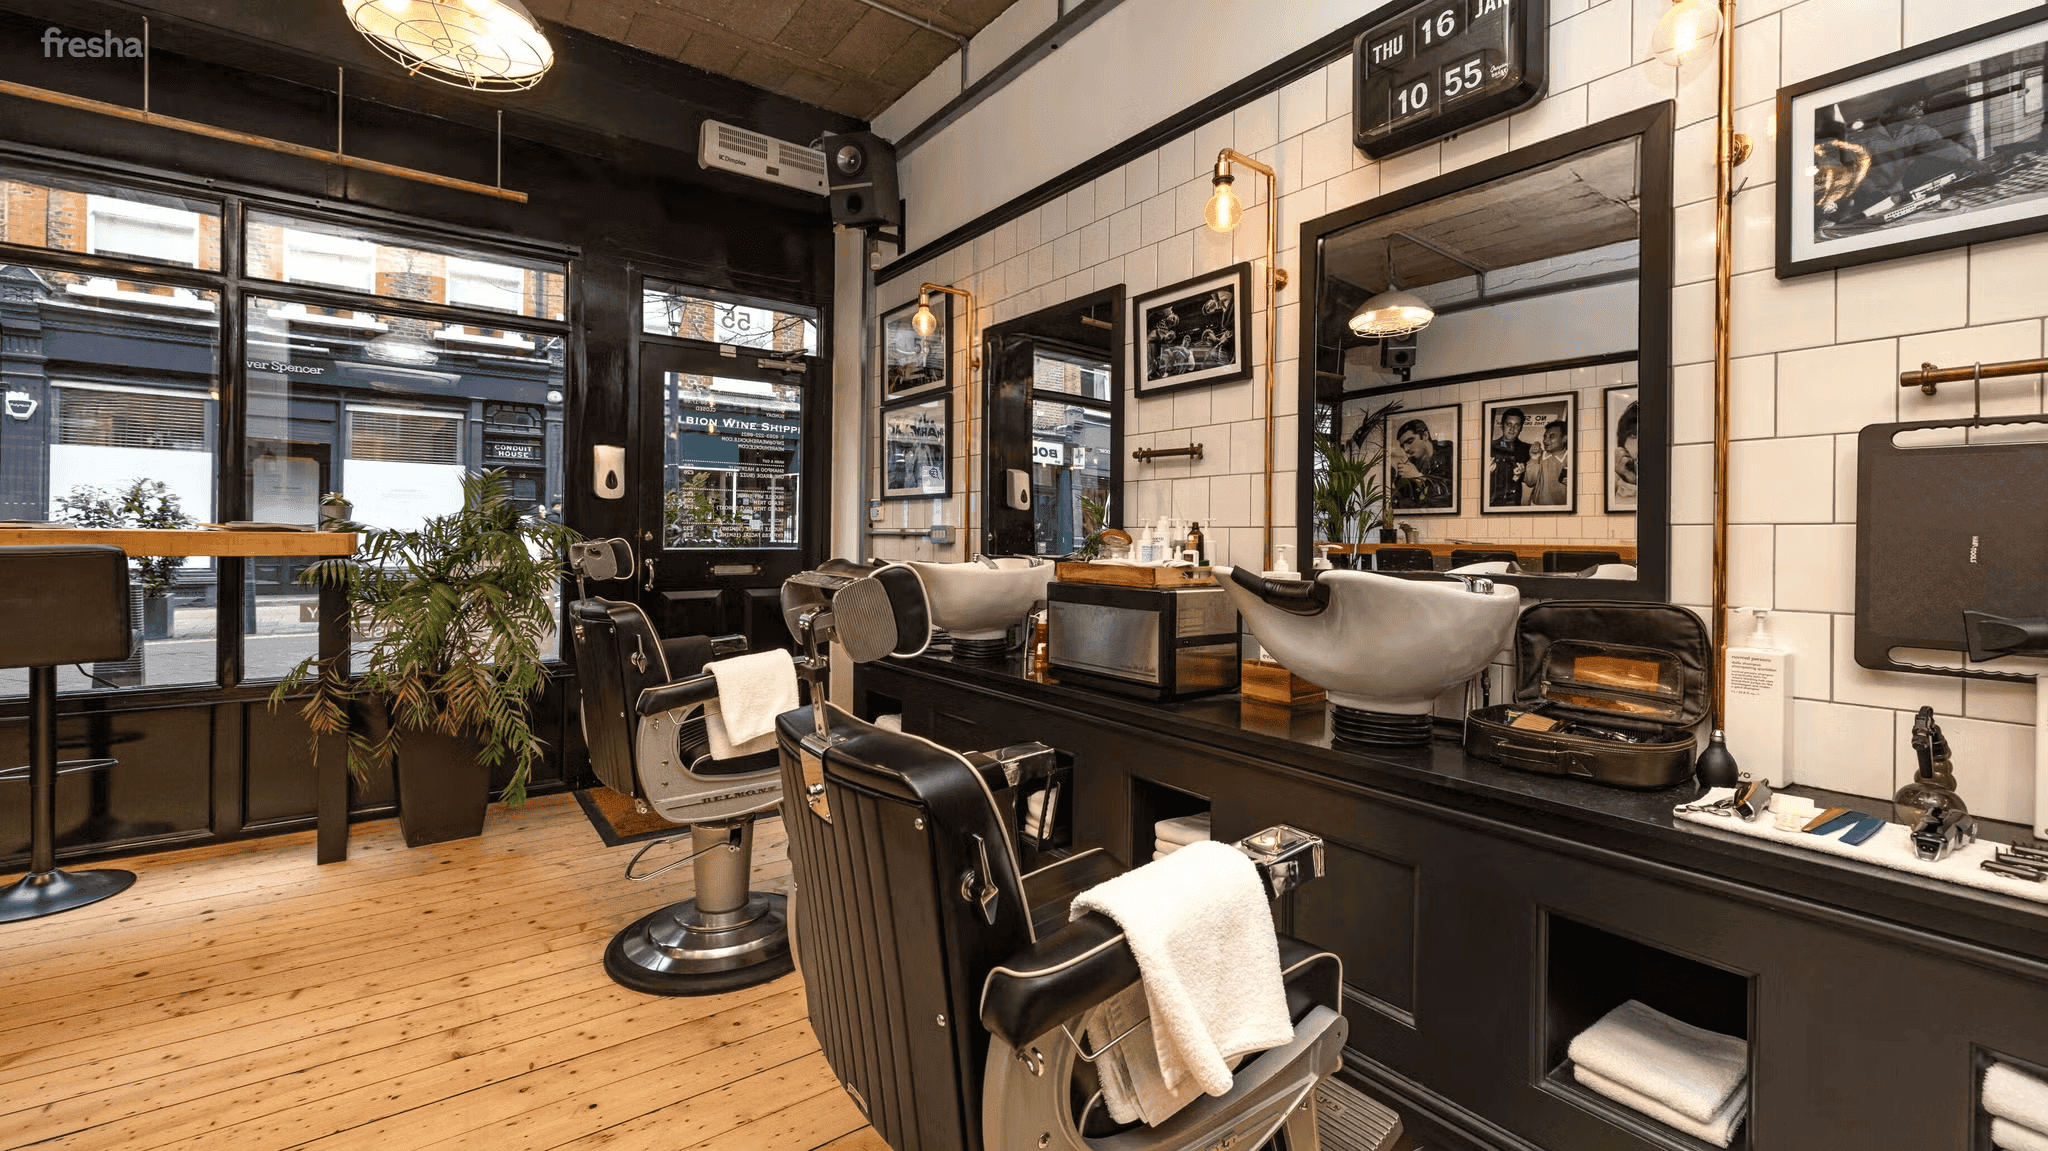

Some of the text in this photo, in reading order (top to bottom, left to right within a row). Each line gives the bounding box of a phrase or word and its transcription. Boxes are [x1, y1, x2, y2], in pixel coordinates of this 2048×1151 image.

[1373, 0, 1509, 64] THU 16 JAN
[1398, 82, 1428, 114] 10
[1444, 58, 1483, 96] 55
[271, 361, 325, 374] Spencer
[722, 417, 757, 430] WINE
[494, 444, 532, 452] CONDUIT
[498, 450, 529, 458] HOUSE
